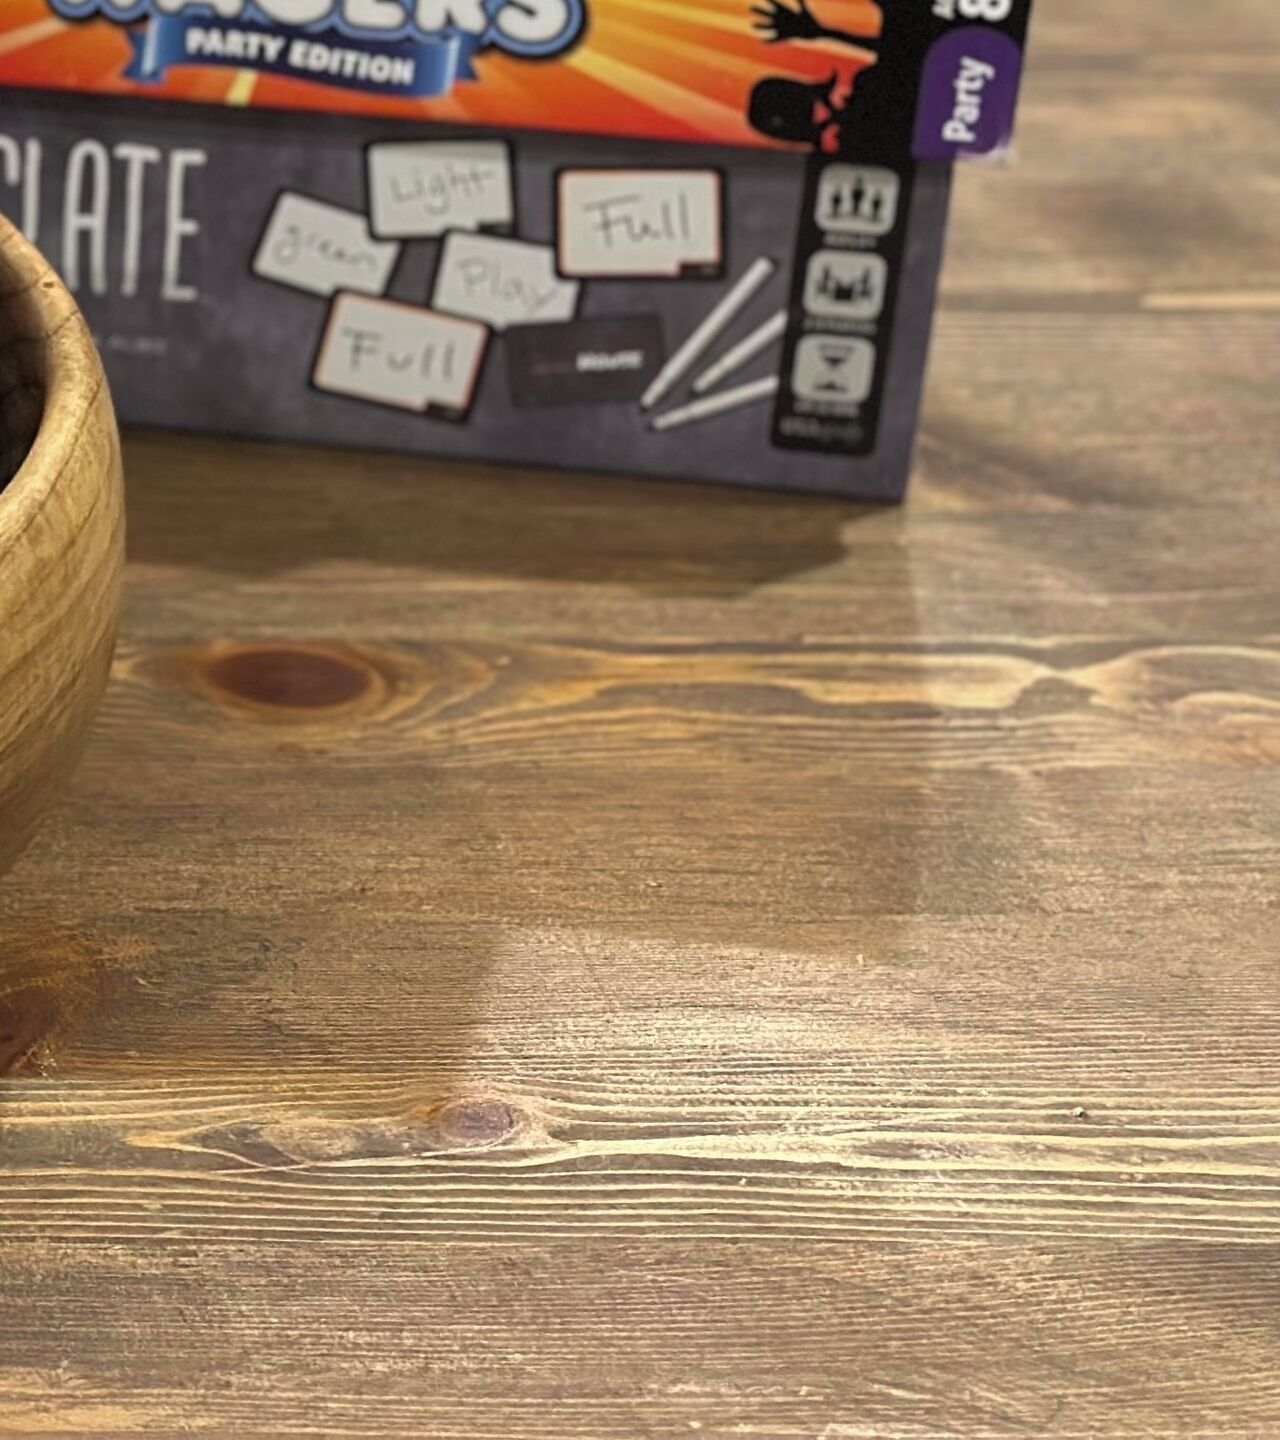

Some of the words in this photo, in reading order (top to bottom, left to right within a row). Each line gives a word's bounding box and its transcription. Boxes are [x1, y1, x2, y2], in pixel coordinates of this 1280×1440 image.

[183, 26, 284, 61] PARTY
[288, 38, 417, 86] EDITION
[942, 55, 997, 144] Party
[390, 163, 494, 217] Light
[582, 191, 690, 249] Full
[458, 255, 559, 316] Play
[342, 325, 457, 384] Full
